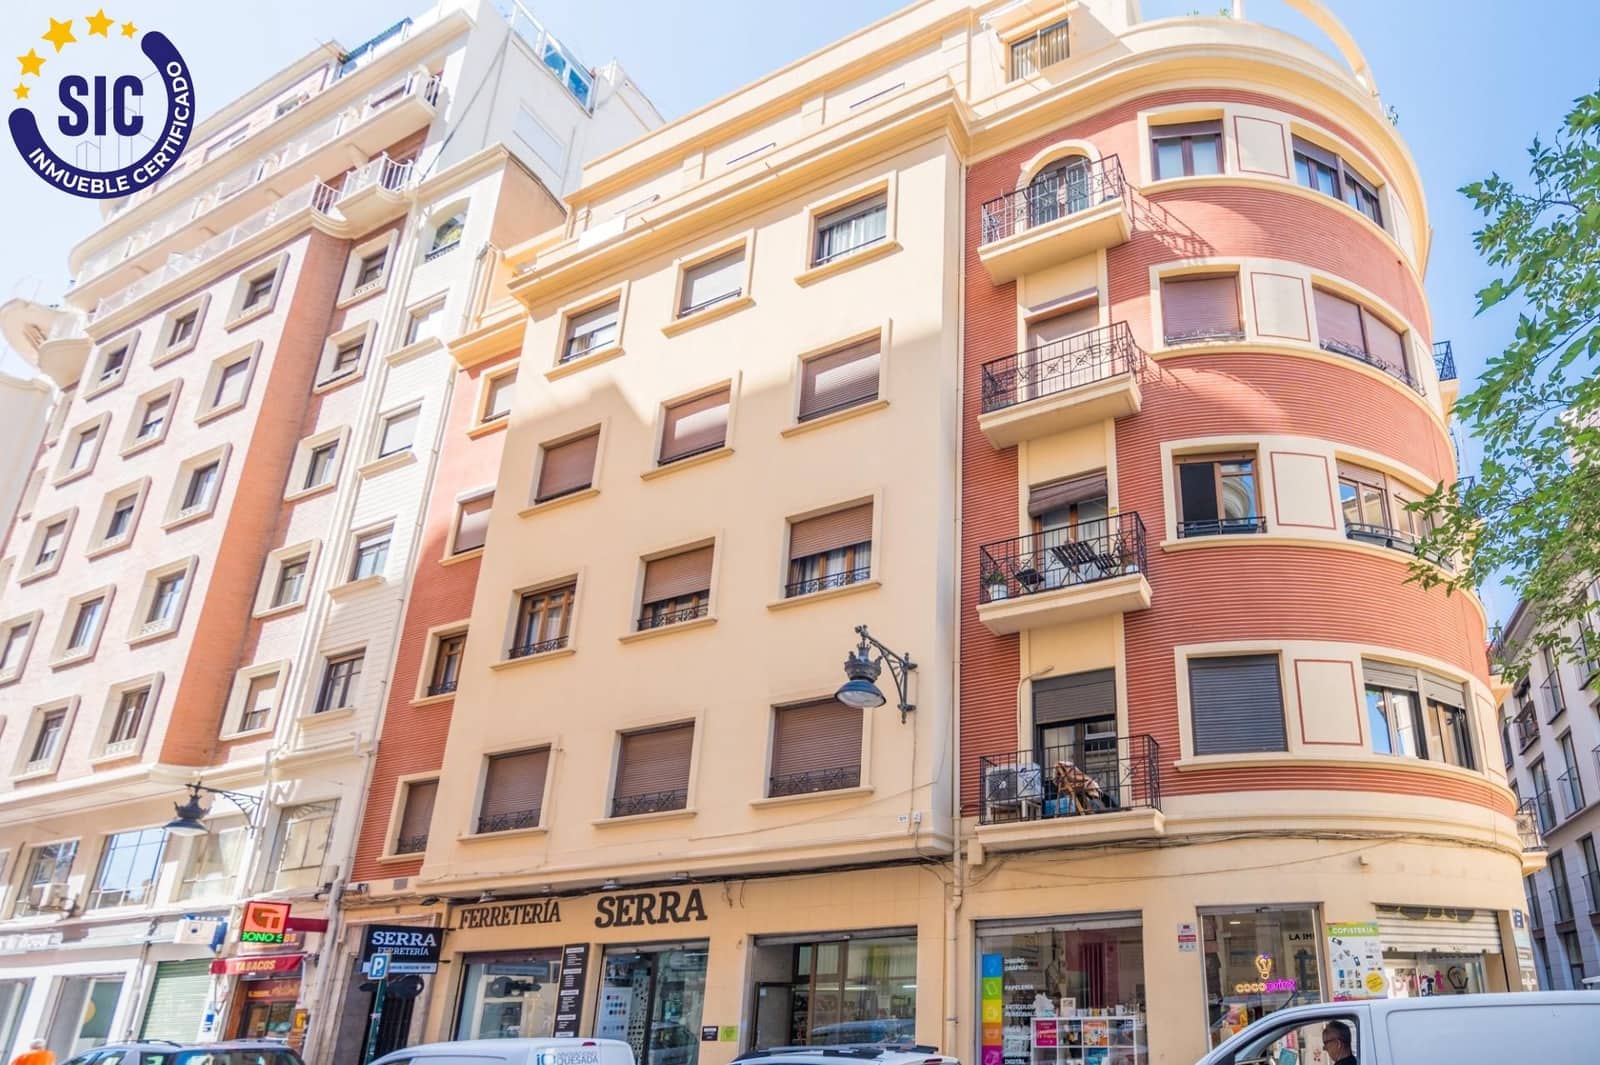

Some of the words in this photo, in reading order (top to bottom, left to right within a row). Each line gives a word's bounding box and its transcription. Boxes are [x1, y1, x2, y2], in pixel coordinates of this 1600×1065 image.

[458, 898, 562, 930] FERRETERÍA
[594, 888, 709, 928] SERRA
[371, 931, 437, 947] SERRA
[1289, 933, 1300, 941] LA
[372, 957, 384, 976] P
